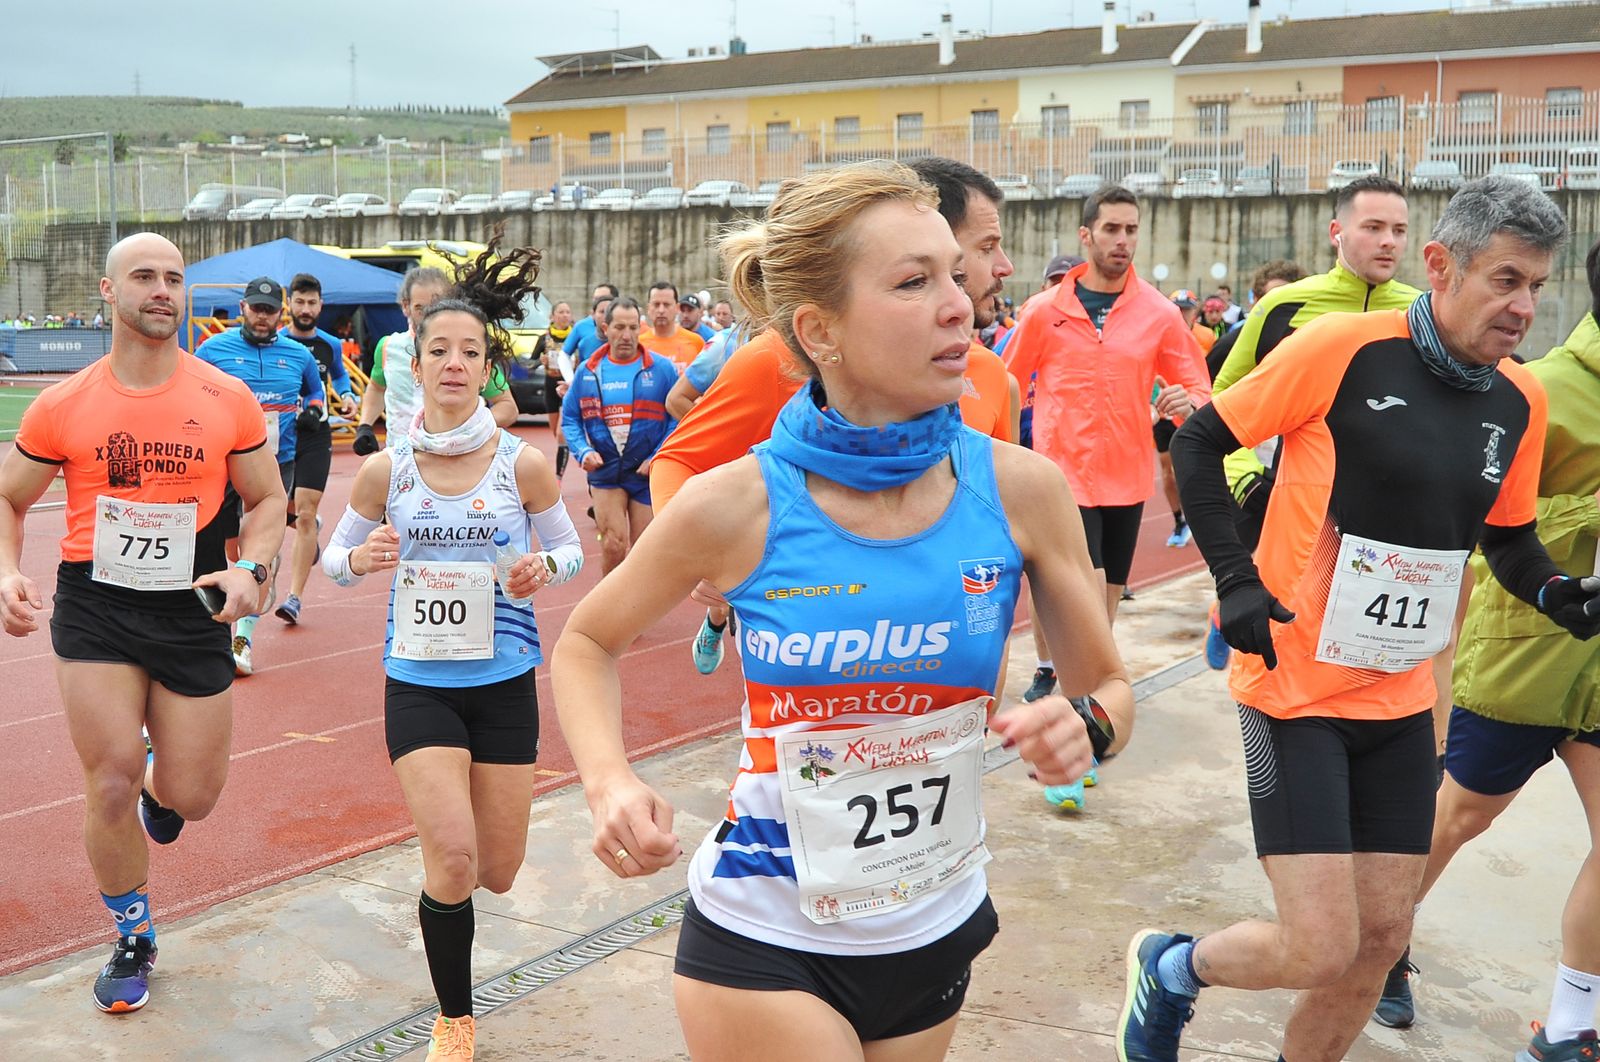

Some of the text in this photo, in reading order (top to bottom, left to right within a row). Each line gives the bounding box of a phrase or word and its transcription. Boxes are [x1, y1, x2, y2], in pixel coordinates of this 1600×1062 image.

[40, 342, 82, 351] MONDO
[95, 442, 205, 462] XXXII PRUEBA
[134, 459, 187, 475] FONDO
[133, 518, 165, 529] LUCENA
[467, 511, 497, 521] mayfo
[119, 533, 170, 560] 775
[427, 581, 459, 590] LUCENA
[1394, 570, 1433, 585] LUCENA
[765, 585, 844, 600] GSPORT
[414, 598, 467, 626] 500
[1364, 593, 1431, 629] 411
[841, 658, 943, 678] directo
[769, 685, 934, 722] Maratón
[872, 748, 935, 769] LUCENA
[847, 774, 951, 850] 257
[862, 854, 909, 873] CONCEPCION
[909, 849, 926, 863] DIAZ
